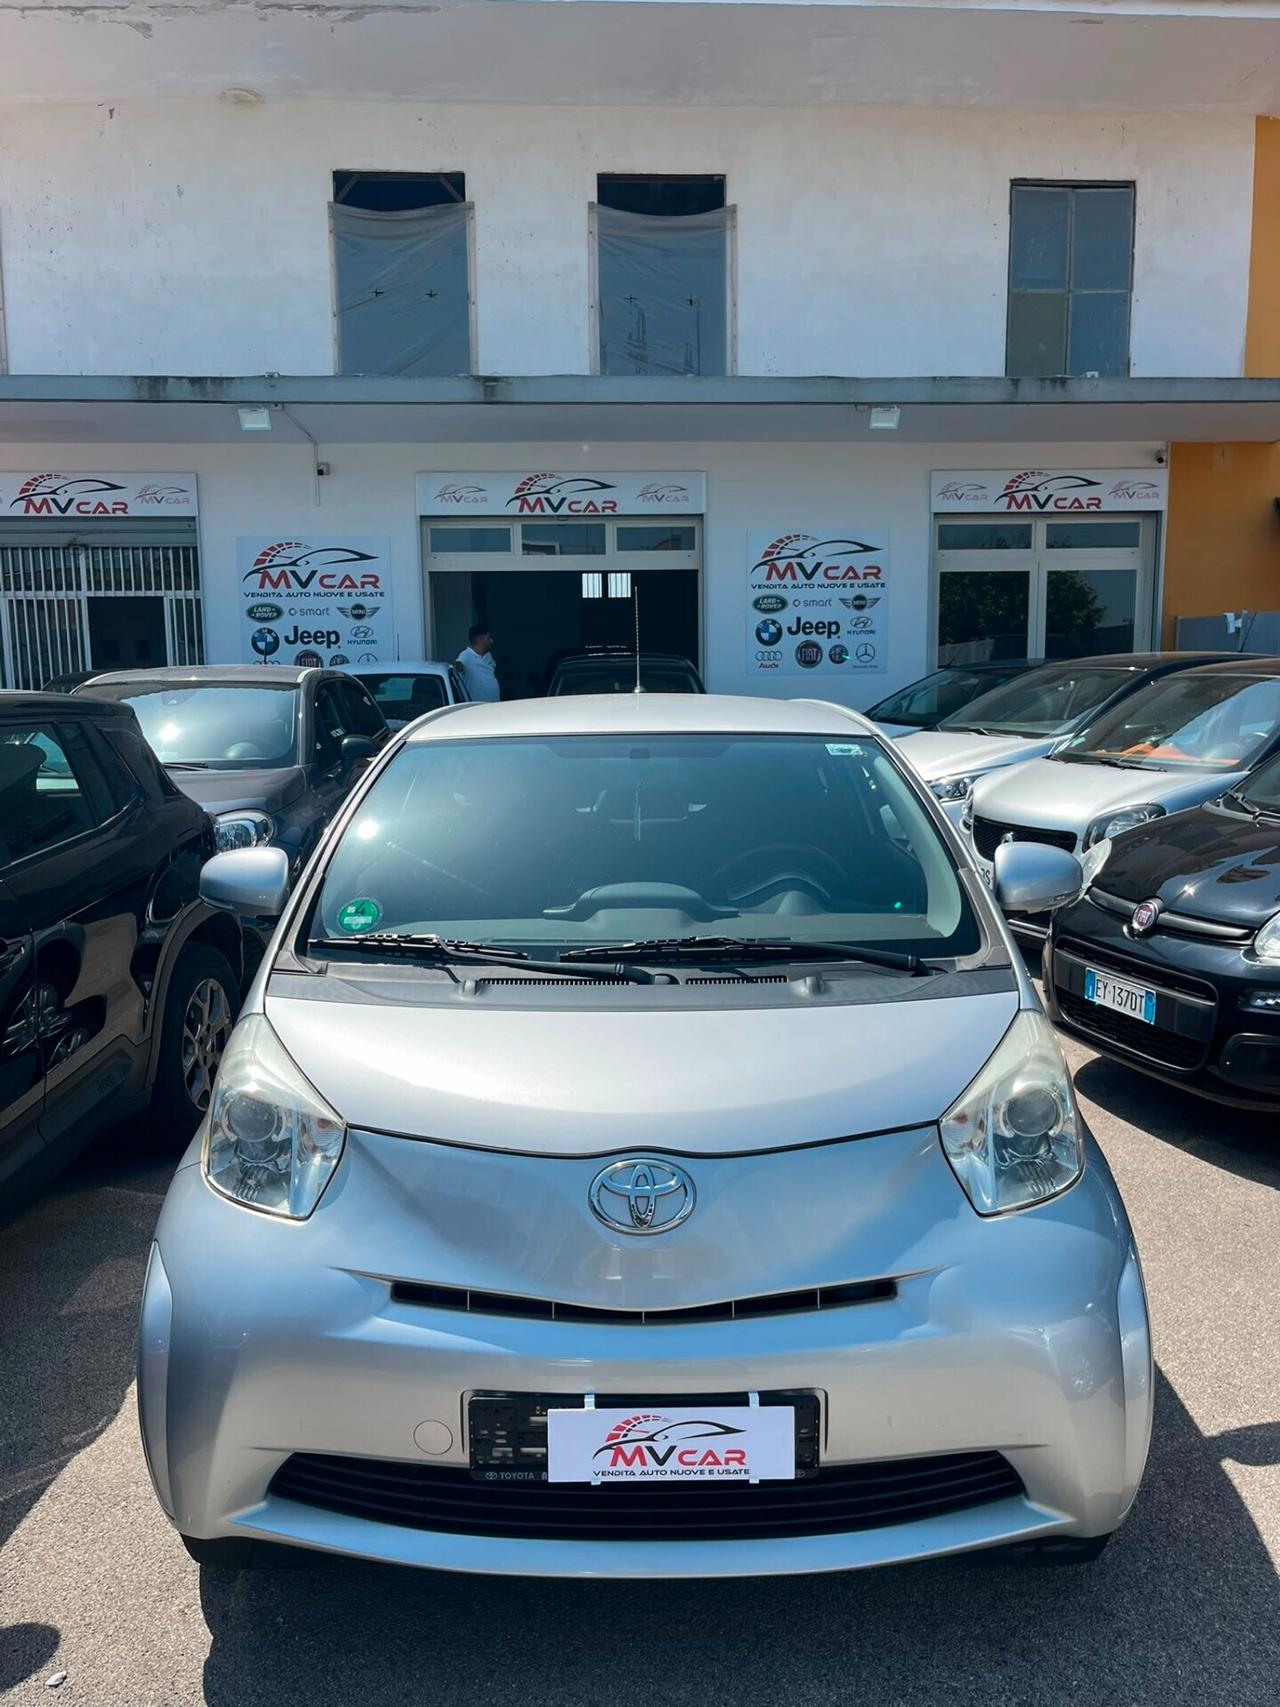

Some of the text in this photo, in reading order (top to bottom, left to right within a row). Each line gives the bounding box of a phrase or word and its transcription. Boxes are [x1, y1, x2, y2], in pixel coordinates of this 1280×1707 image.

[802, 598, 832, 607] smart
[299, 607, 330, 616] smart
[787, 616, 840, 639] Jeep
[284, 626, 341, 649] Jeep
[801, 648, 818, 661] FIAT
[1136, 909, 1152, 923] FIAT
[1095, 979, 1145, 1013] EY 137DT
[500, 1472, 535, 1480] TOYOTA
